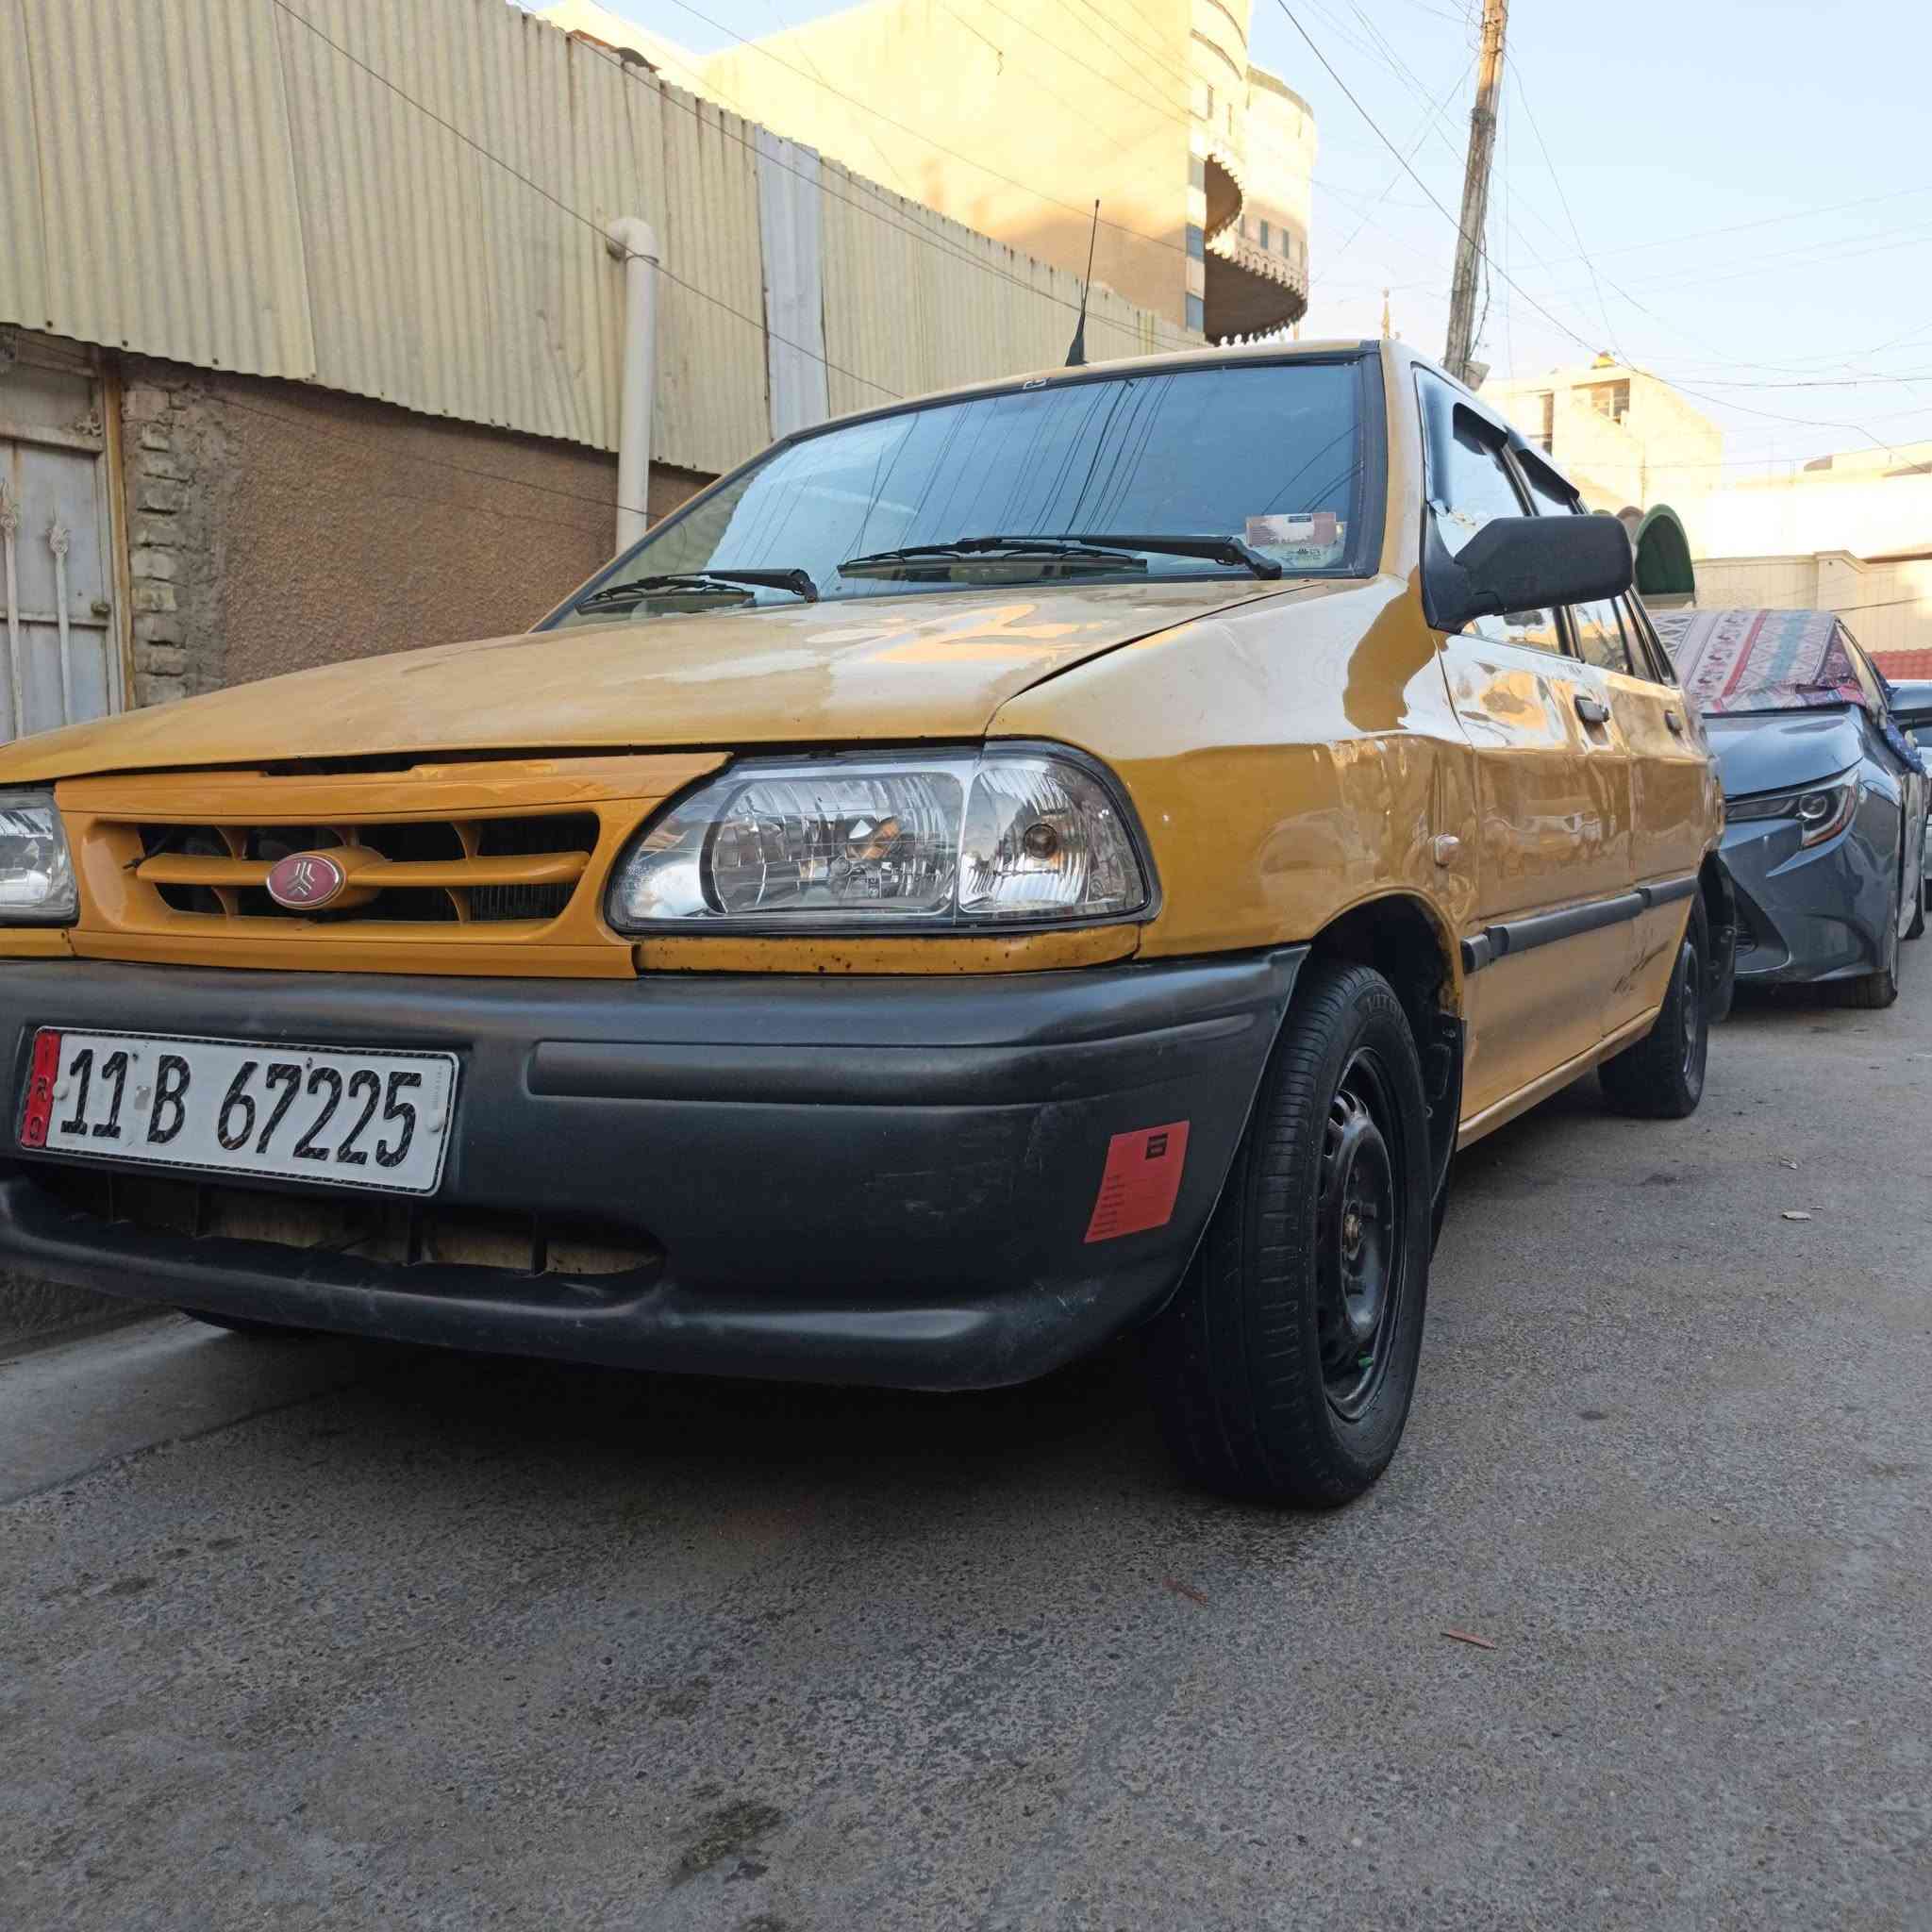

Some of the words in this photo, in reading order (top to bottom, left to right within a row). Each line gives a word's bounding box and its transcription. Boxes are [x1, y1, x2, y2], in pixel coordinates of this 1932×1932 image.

[60, 1048, 128, 1139] 11
[147, 1055, 191, 1143] B
[217, 1061, 422, 1168] 67225
